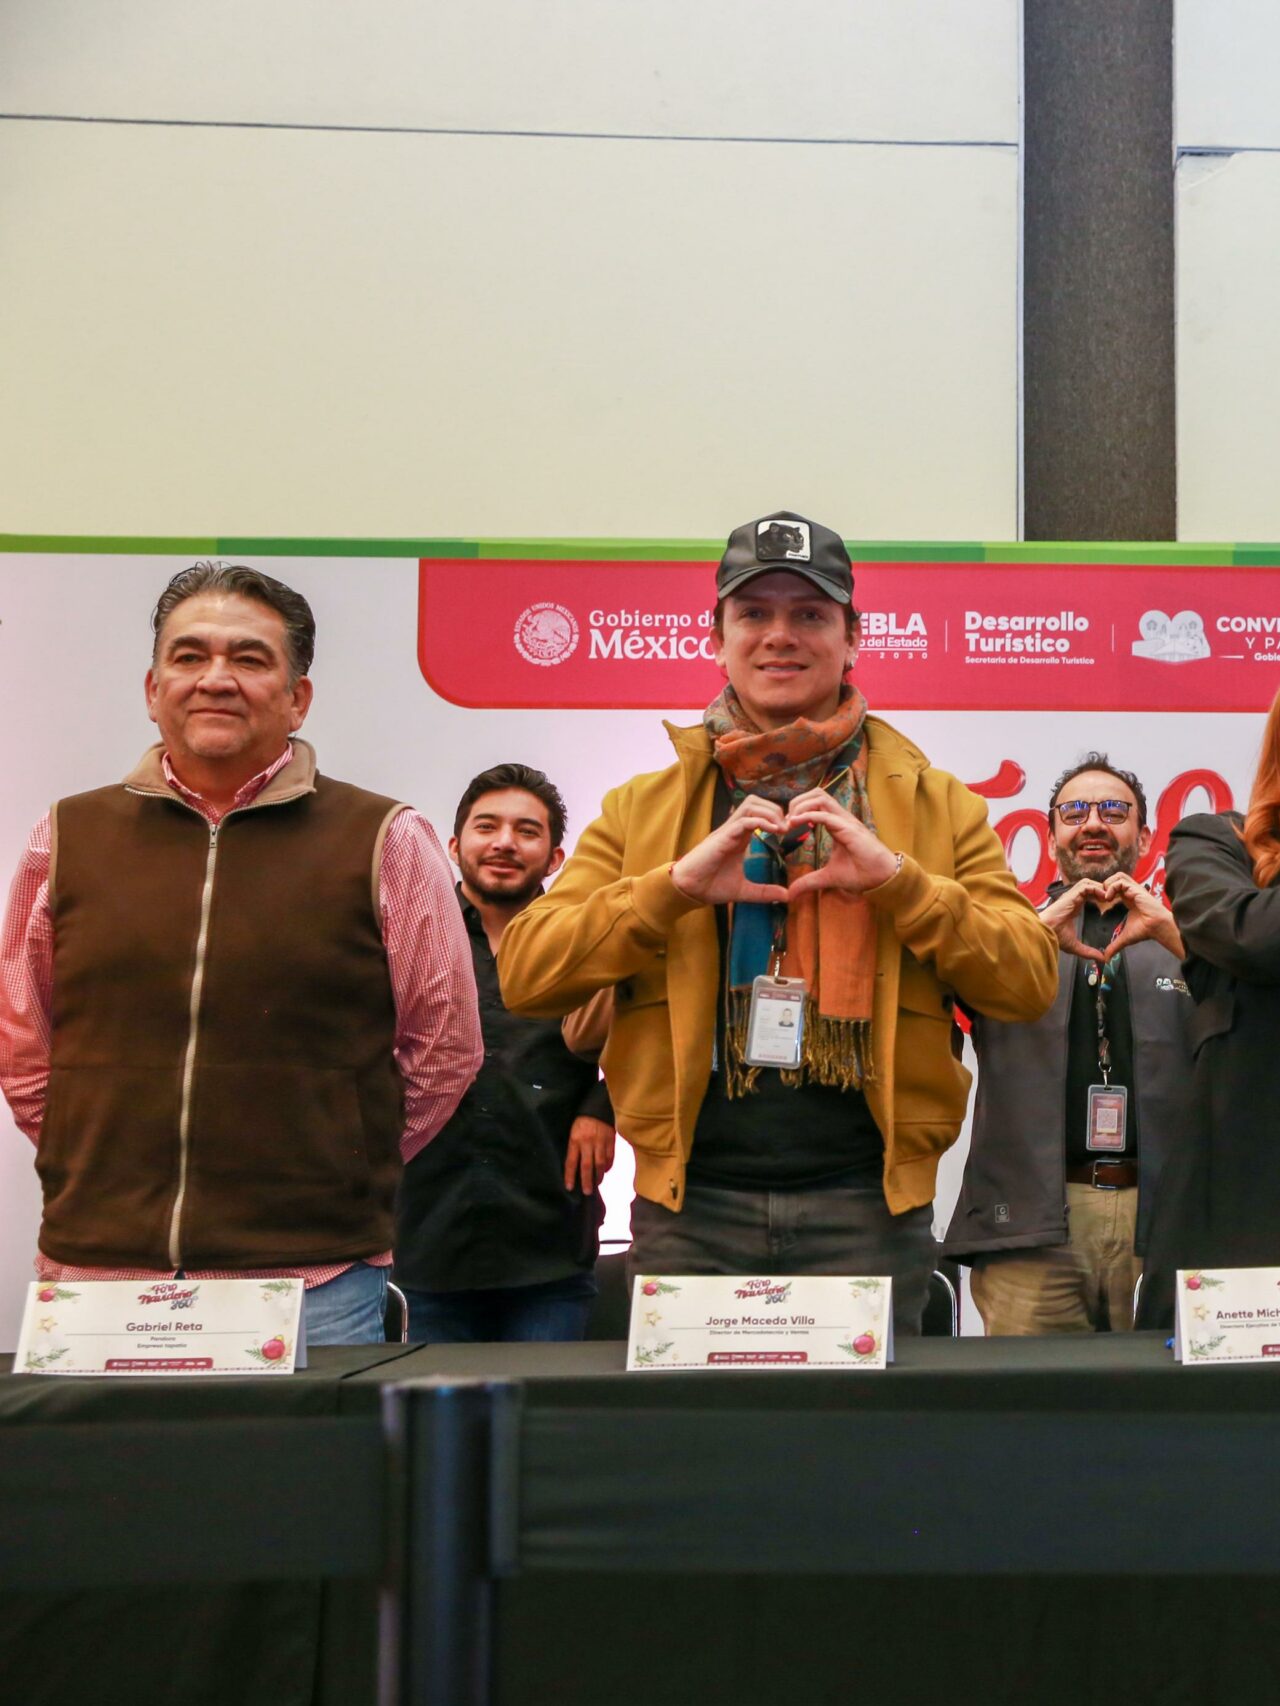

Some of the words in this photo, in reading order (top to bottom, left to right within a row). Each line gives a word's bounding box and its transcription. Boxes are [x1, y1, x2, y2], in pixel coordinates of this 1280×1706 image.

[589, 610, 692, 627] Gobierno
[965, 611, 1089, 631] Desarrollo
[588, 628, 716, 660] México
[867, 637, 885, 647] del
[887, 637, 928, 647] Estado
[965, 632, 1070, 653] Turístico
[1245, 637, 1255, 649] Y
[1008, 656, 1018, 664] de
[1020, 656, 1060, 665] Desarrollo
[1216, 1310, 1254, 1320] Anette
[126, 1322, 171, 1332] Gabriel
[175, 1321, 203, 1332] Reta
[705, 1316, 738, 1328] Jorge
[741, 1316, 787, 1326] Maceda
[790, 1316, 815, 1326] Villa
